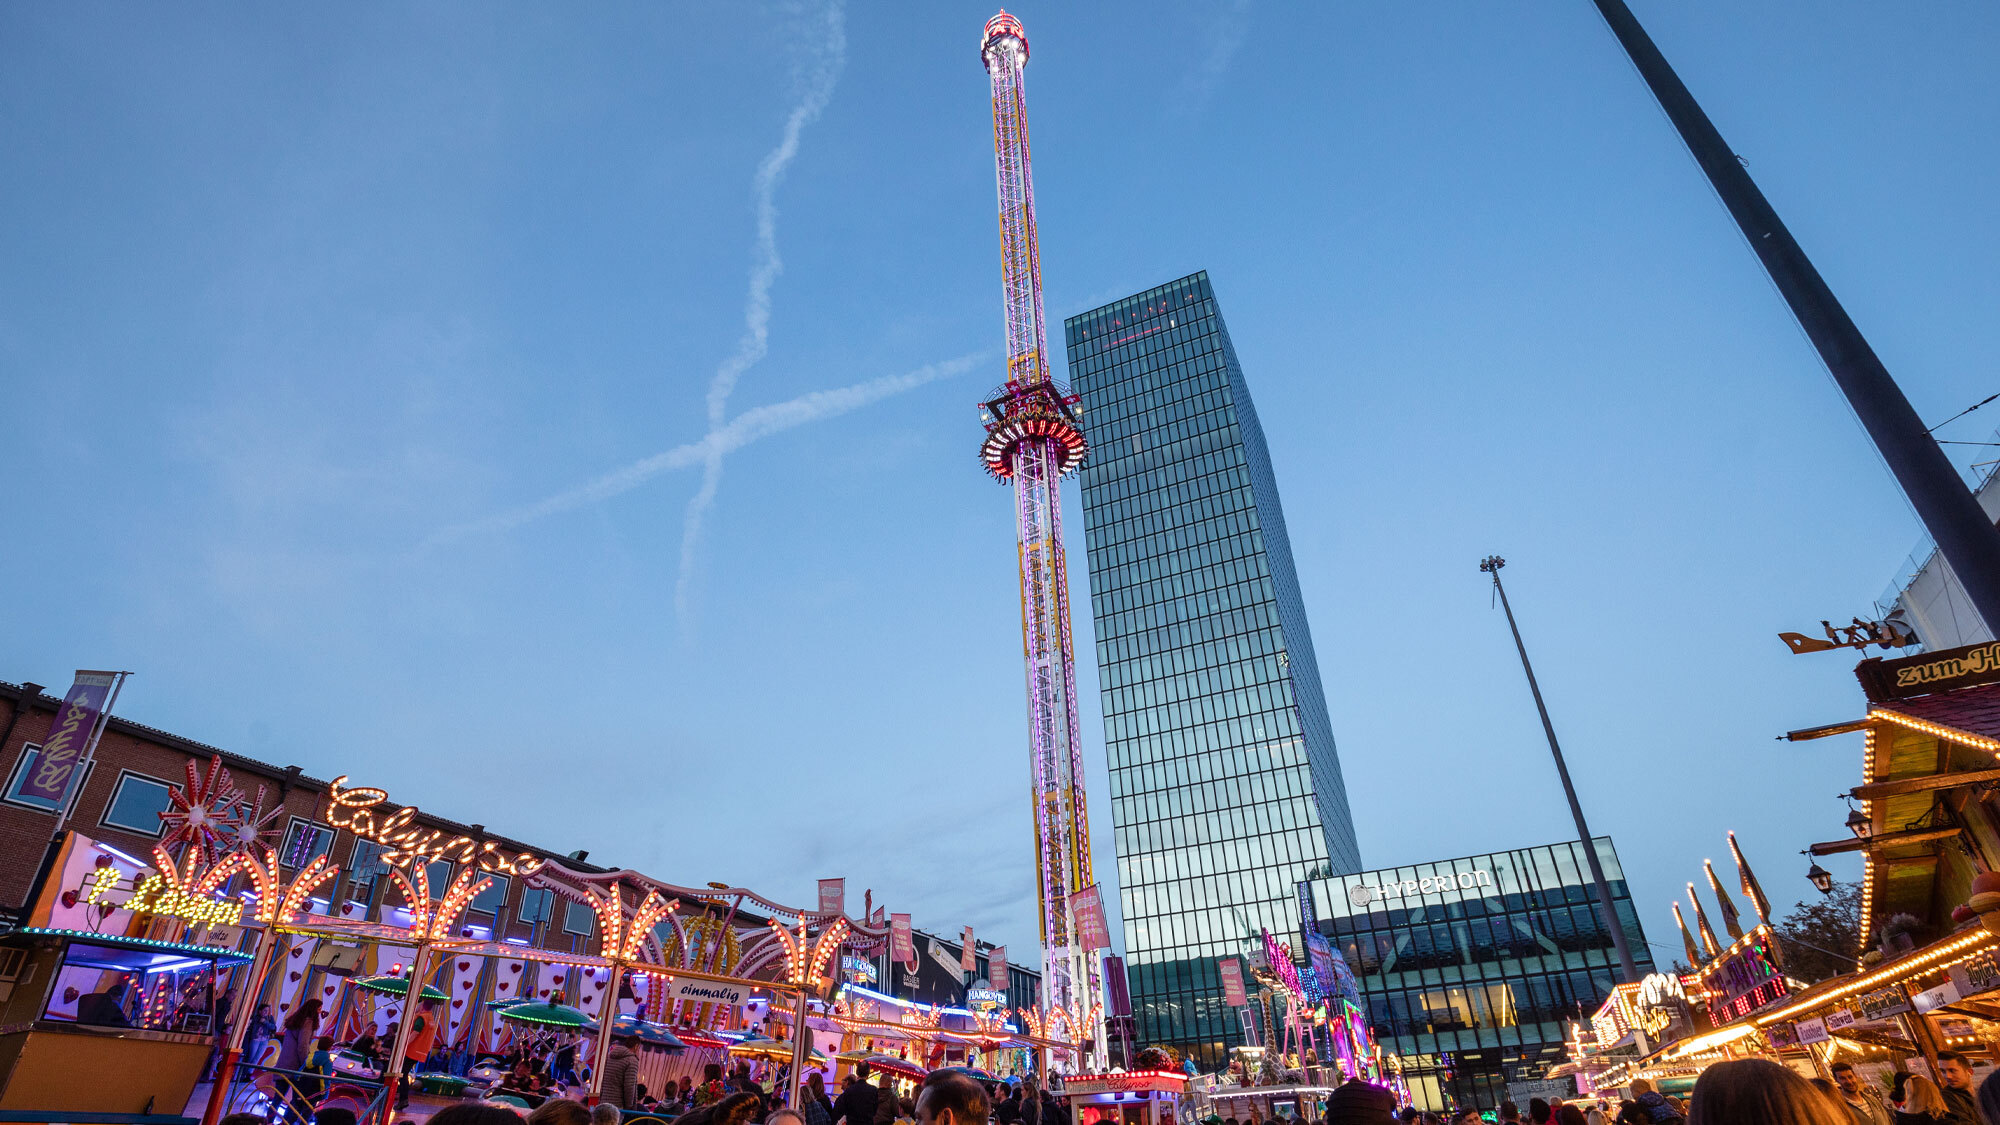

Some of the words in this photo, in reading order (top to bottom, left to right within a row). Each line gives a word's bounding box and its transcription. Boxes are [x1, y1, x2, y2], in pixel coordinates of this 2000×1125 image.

[1897, 658, 1966, 687] zum
[326, 775, 543, 876] Calypso
[1374, 869, 1492, 901] HYPERION
[680, 984, 740, 1003] einmalig
[968, 990, 1007, 1005] HANGOVER
[1106, 1079, 1152, 1091] Calypso
